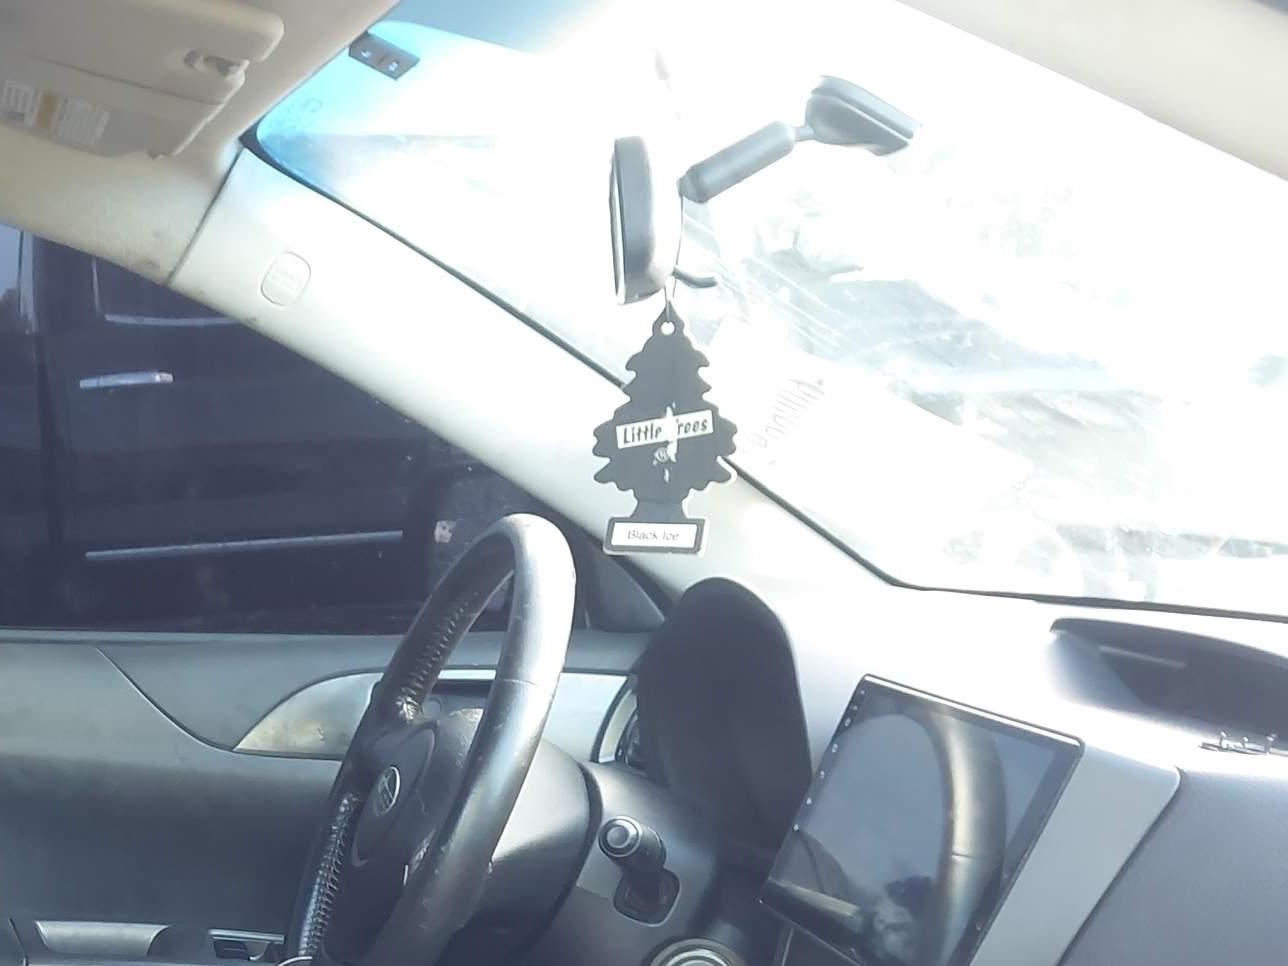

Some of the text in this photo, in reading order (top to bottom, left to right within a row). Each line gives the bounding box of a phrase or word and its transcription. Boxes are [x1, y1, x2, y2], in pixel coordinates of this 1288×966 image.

[676, 418, 708, 435] rees
[627, 529, 680, 541] Black Ice
